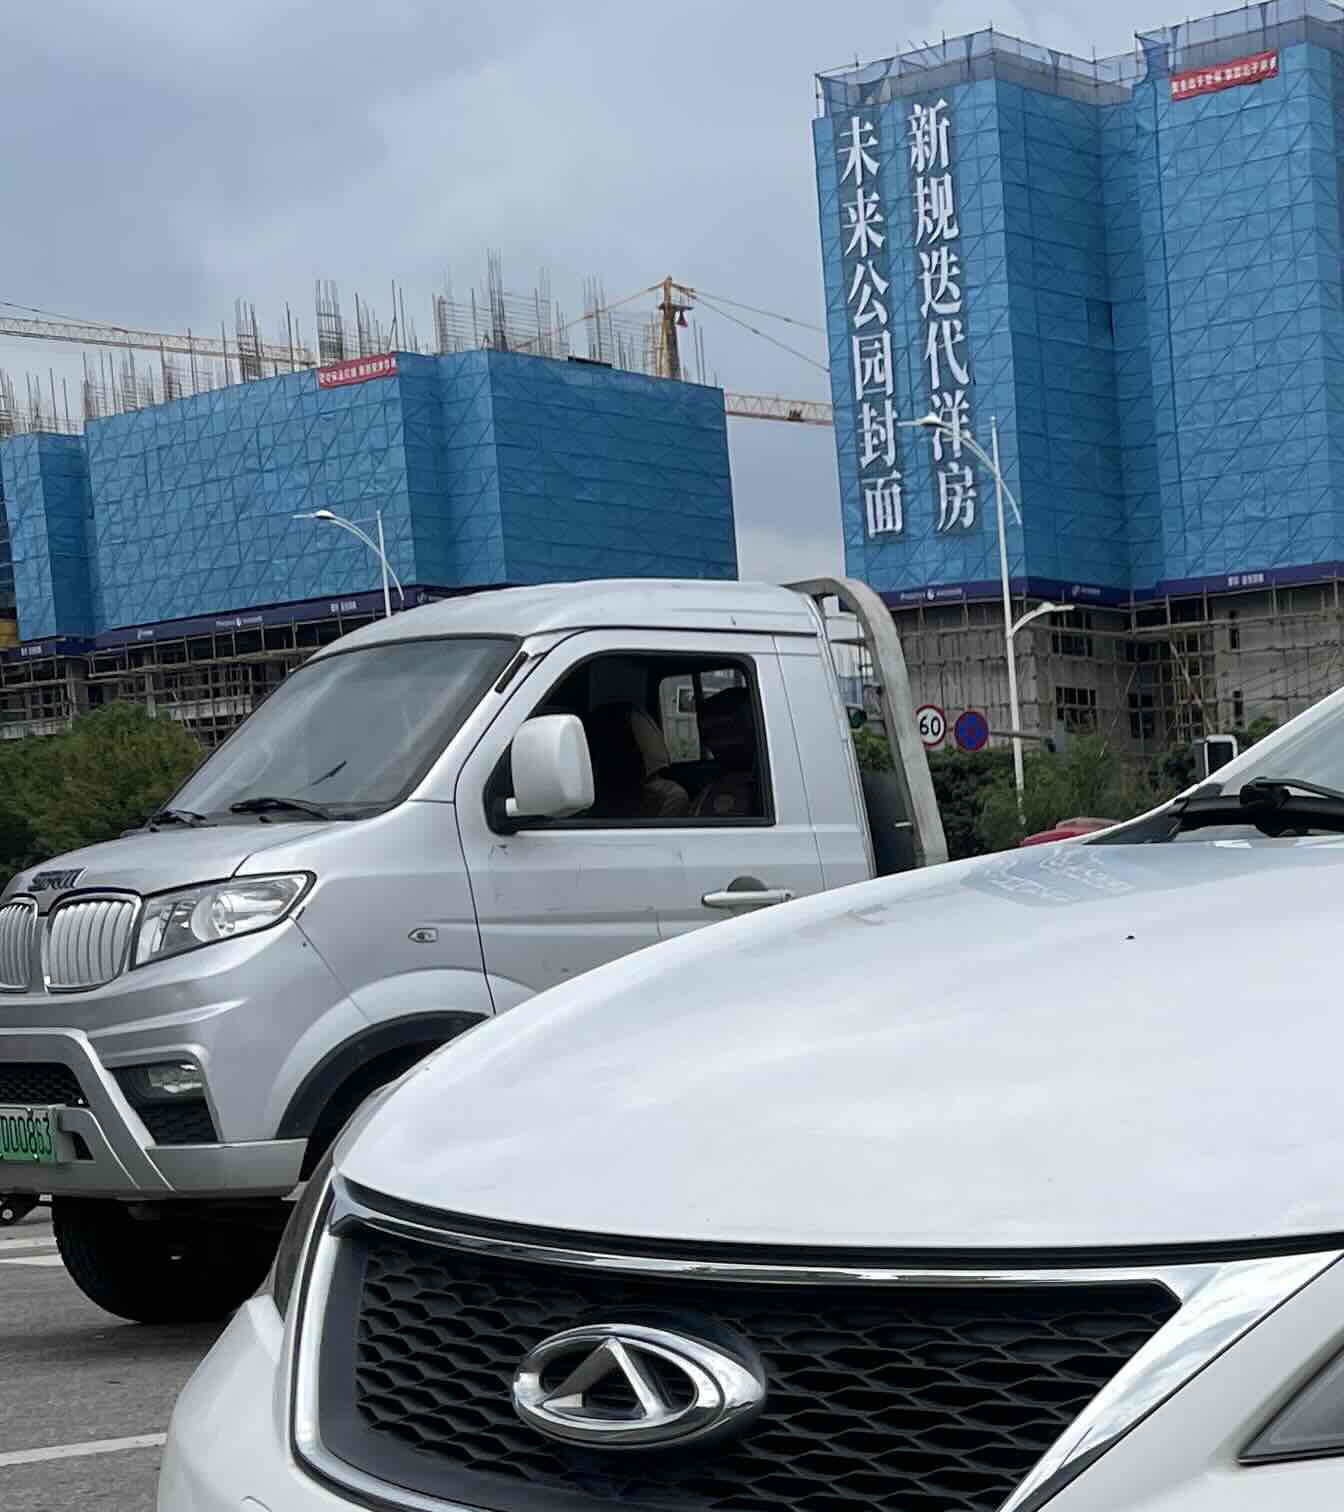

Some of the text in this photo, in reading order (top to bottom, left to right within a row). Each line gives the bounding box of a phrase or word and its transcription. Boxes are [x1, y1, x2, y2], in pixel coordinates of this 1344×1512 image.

[837, 115, 903, 539] 未来公园封面
[907, 98, 977, 532] 新规迭代洋房
[919, 715, 941, 737] 60
